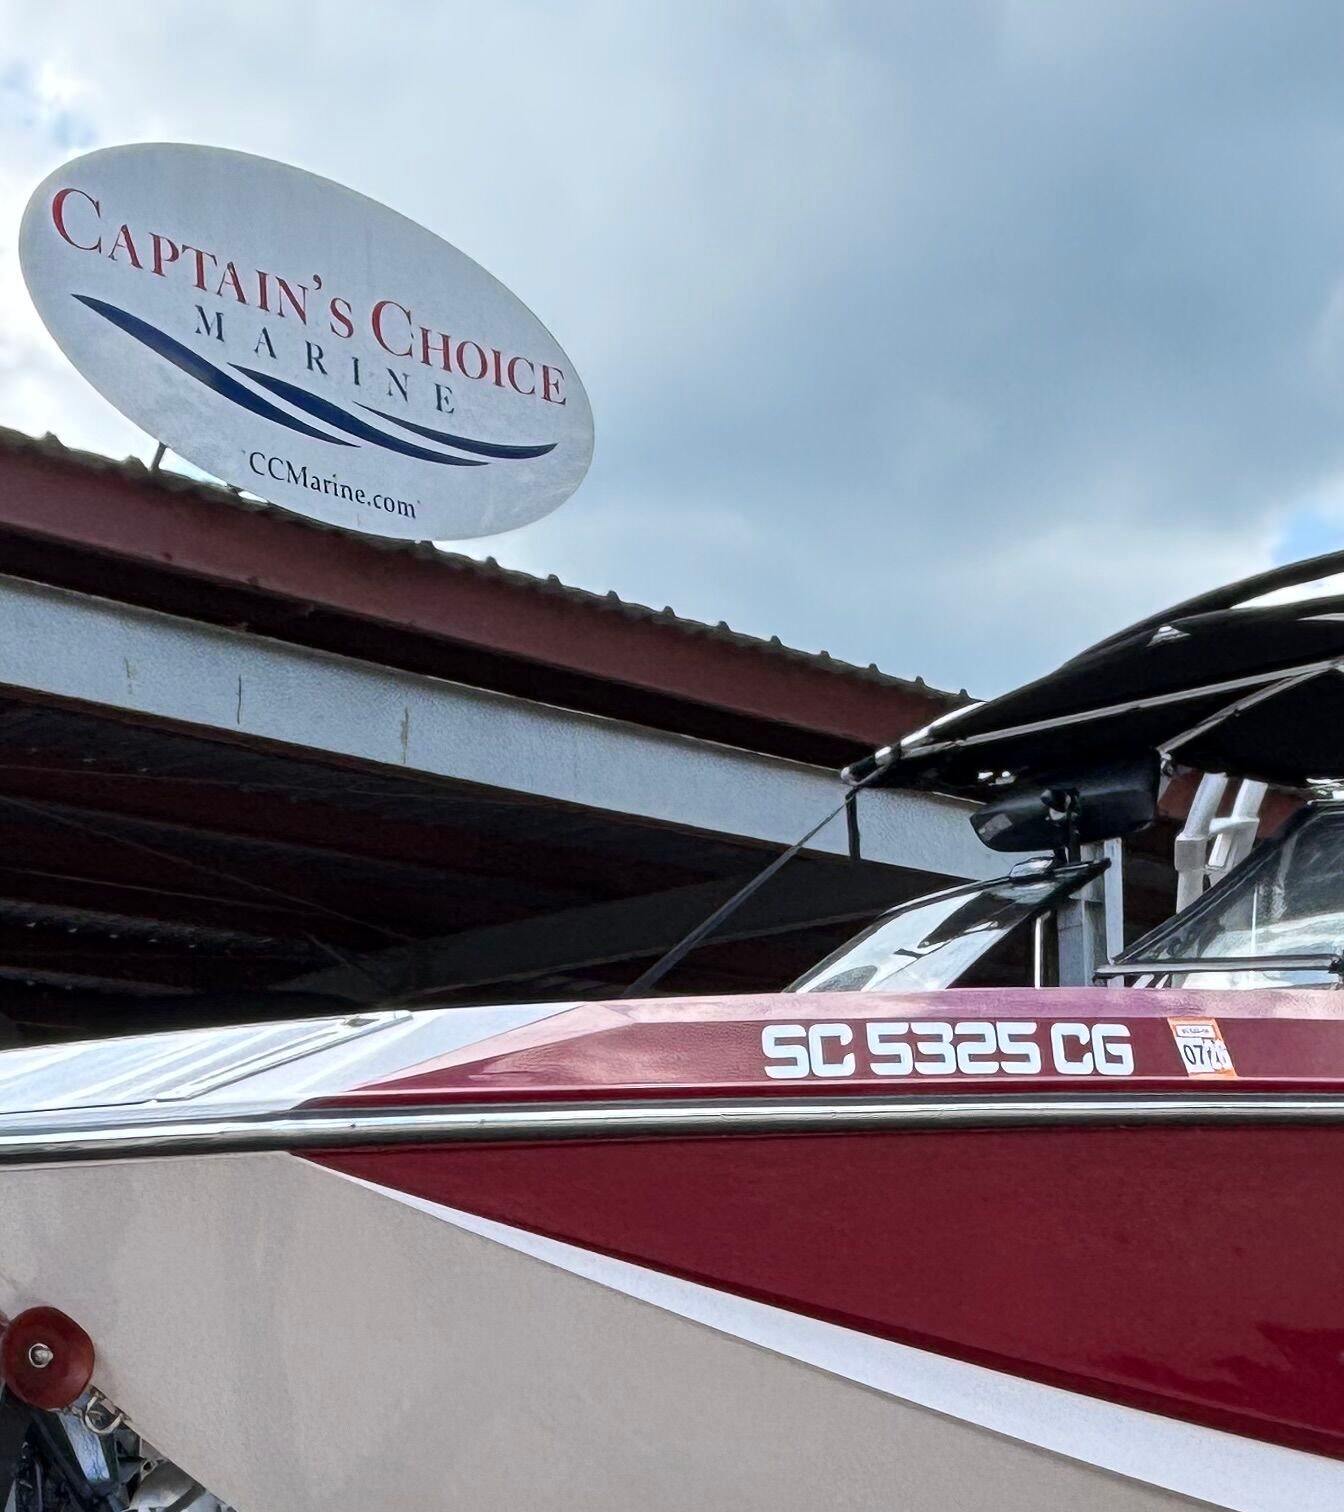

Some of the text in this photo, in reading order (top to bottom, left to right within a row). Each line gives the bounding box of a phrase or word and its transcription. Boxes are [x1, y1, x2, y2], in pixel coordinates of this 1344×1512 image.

[51, 187, 568, 406] CAPTAIN'S CHOICE
[195, 304, 456, 415] MARINE
[248, 451, 418, 520] CCMarine.com
[761, 1021, 1135, 1079] SC 5325 CG
